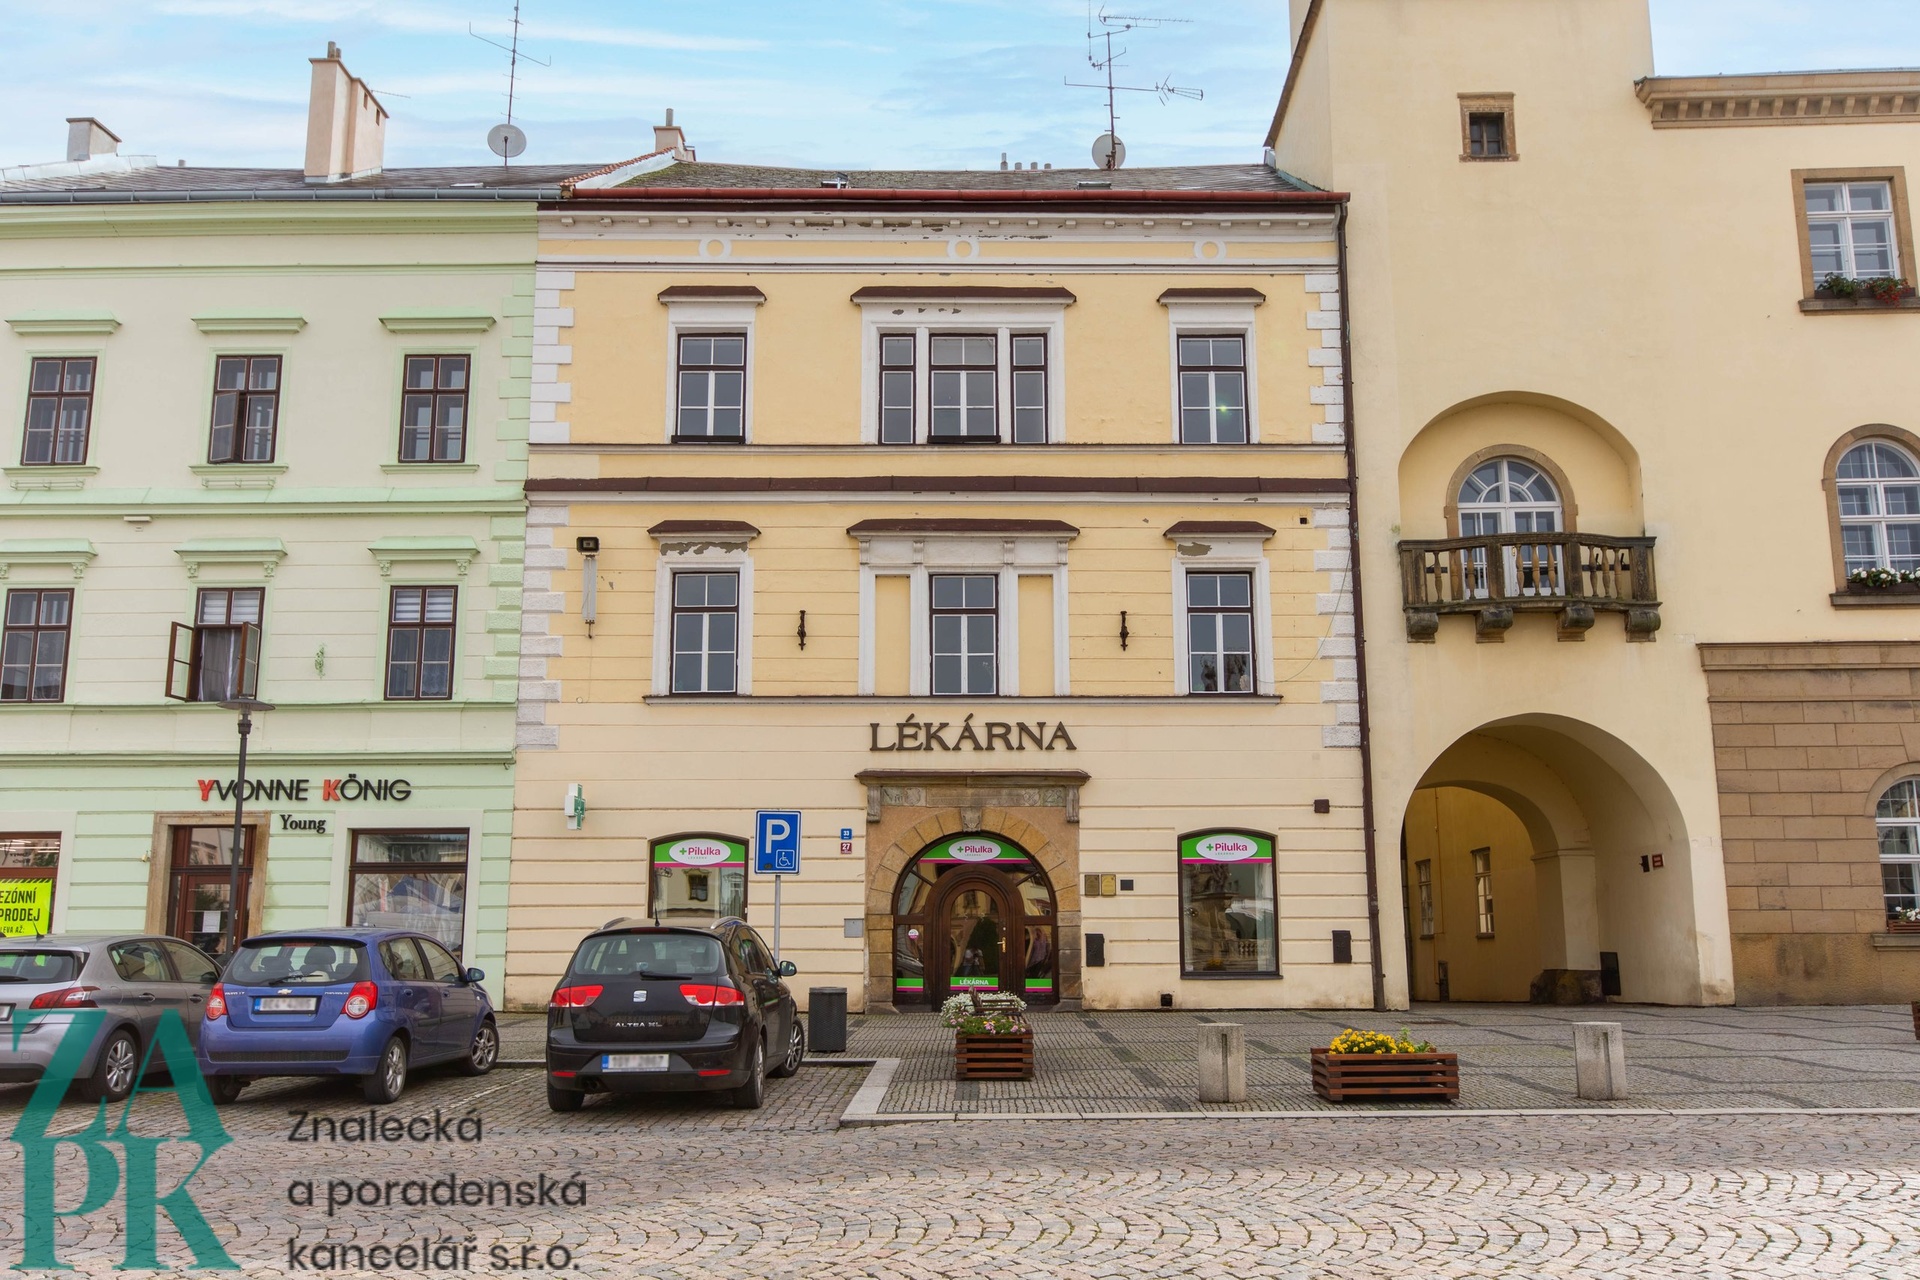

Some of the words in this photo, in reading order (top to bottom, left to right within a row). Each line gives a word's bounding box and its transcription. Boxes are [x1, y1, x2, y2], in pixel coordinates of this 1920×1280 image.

[869, 712, 1078, 751] LÉKÁRNA
[197, 779, 310, 802] YVONNE
[322, 773, 412, 802] KÖNIG
[279, 814, 327, 834] Young
[765, 819, 791, 854] P
[687, 846, 721, 856] Pilulka
[964, 845, 993, 854] Pilulka
[1214, 842, 1248, 852] Pilulka
[959, 977, 989, 985] LÉKÁRNA
